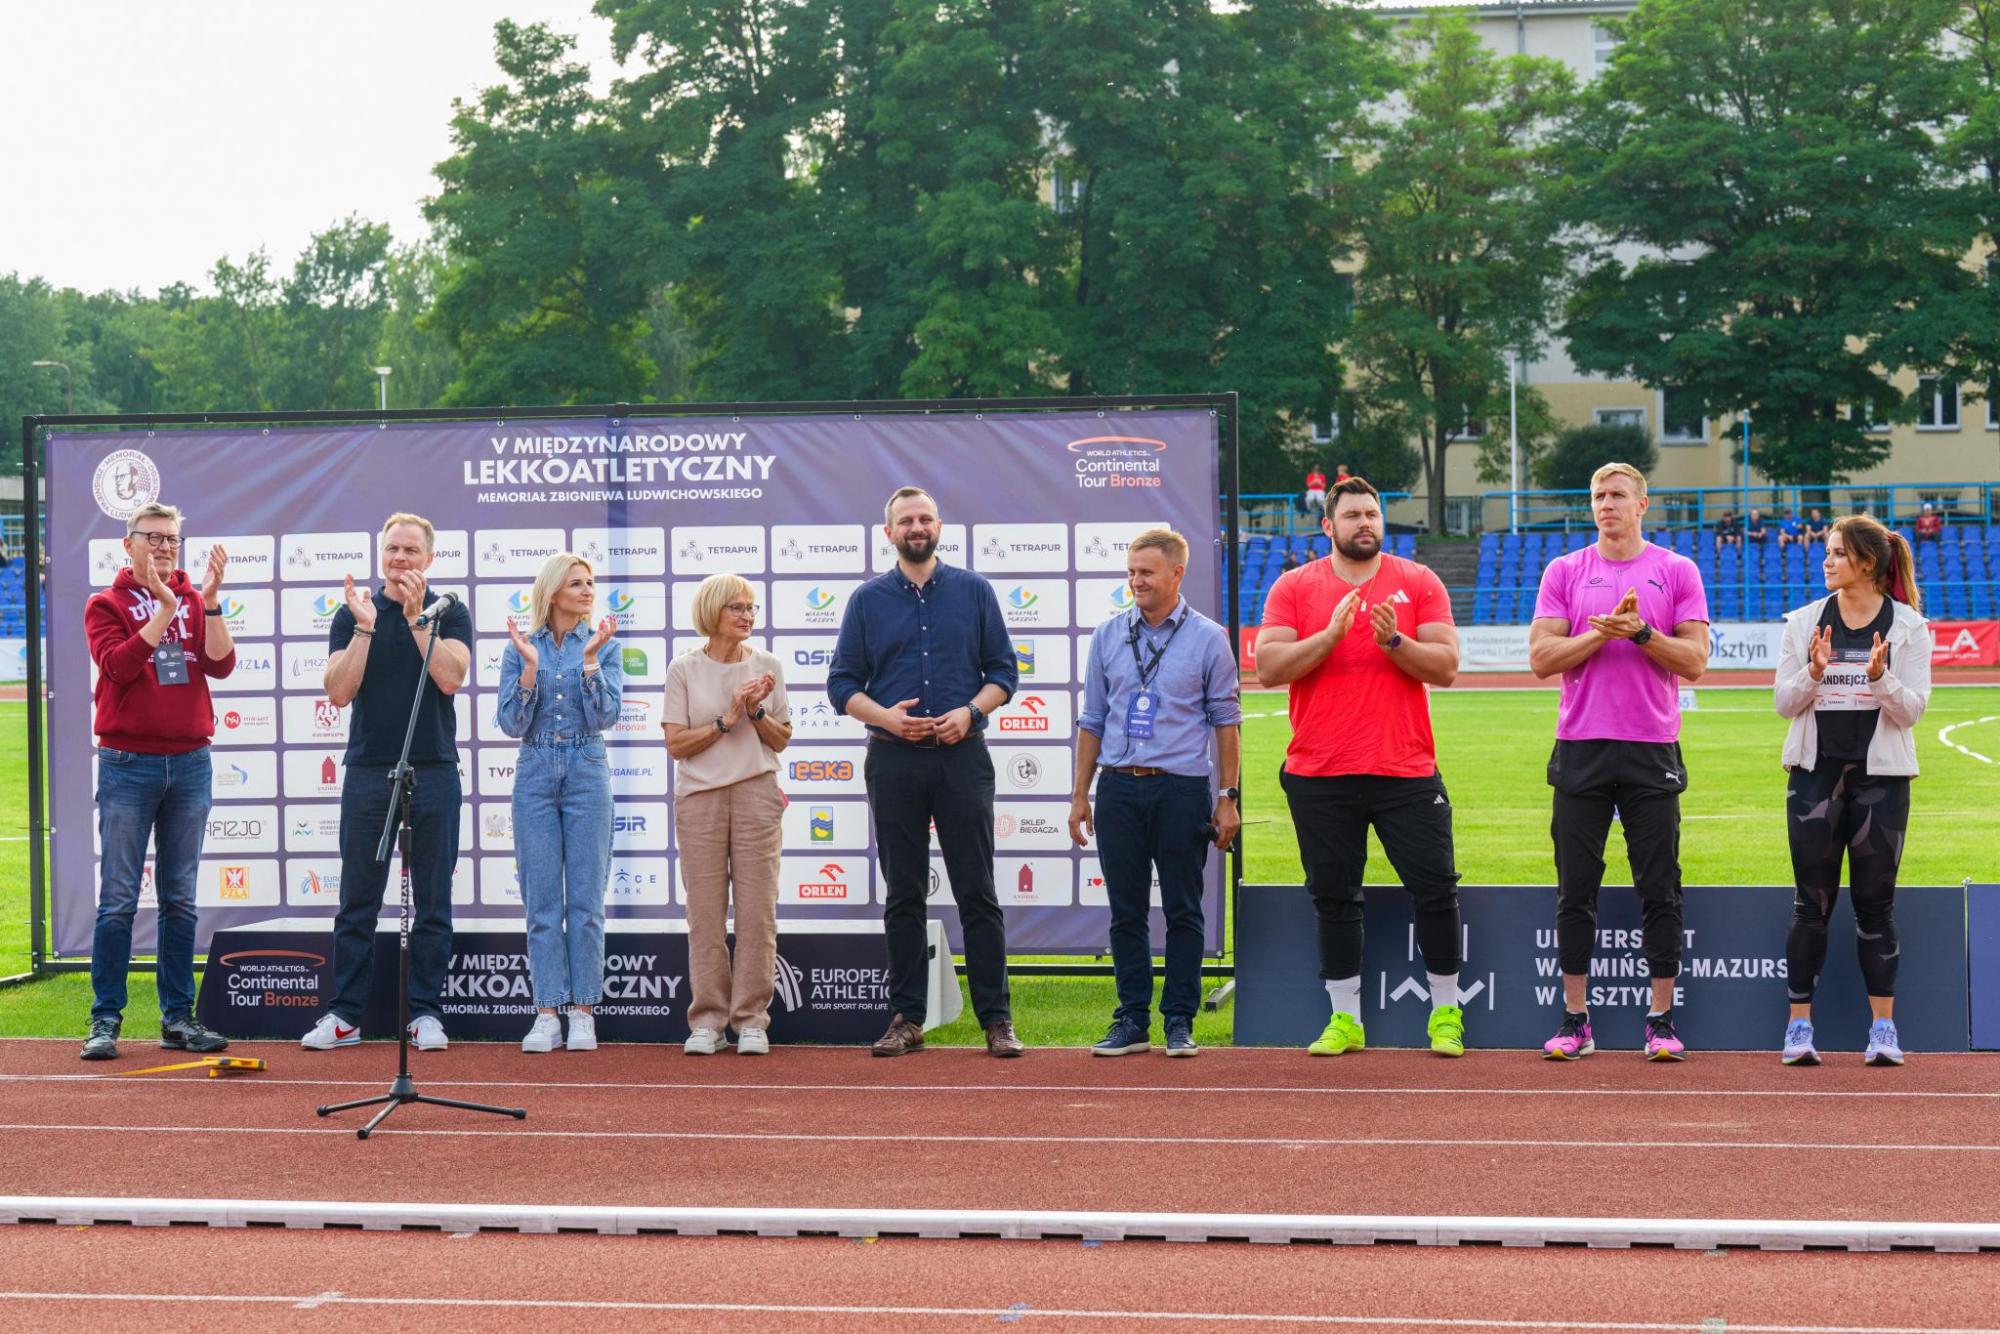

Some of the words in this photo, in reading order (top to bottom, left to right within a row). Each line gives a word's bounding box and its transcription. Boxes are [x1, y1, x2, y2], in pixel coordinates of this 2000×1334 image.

[490, 437, 509, 455] V
[513, 433, 747, 458] MIĘDZYNARODOWY
[1112, 449, 1147, 457] ATHLETICS
[464, 455, 776, 485] LEKKOATLETYCZNY
[1075, 458, 1160, 472] Continental
[1075, 474, 1108, 488] Tour
[1110, 473, 1161, 487] Bronze
[477, 491, 547, 503] MEMORIAŁ
[550, 490, 624, 502] ZBIGNIEWA
[627, 488, 763, 501] LUDWICHOWSKIEGO
[510, 549, 558, 557] TETRAPUR
[608, 548, 657, 556] TETRAPUR
[707, 546, 758, 555] TETRAPUR
[808, 545, 858, 553] TETRAPUR
[1010, 544, 1061, 552] TETRAPUR
[230, 555, 267, 565] TRAPUR
[315, 552, 363, 561] TETRAPUR
[433, 551, 460, 559] APUR
[1931, 628, 1979, 651] LA
[1820, 674, 1868, 687] ANDREJCZ
[616, 713, 647, 722] nental
[1002, 718, 1046, 729] ORLEN
[488, 767, 514, 778] TVP
[609, 768, 653, 777] EGANIE.PL
[614, 816, 646, 831] SiR
[1020, 826, 1059, 834] BIEGACZA
[801, 886, 845, 897] ORLEN
[811, 968, 889, 983] EUROPEA
[228, 974, 318, 989] Continental
[811, 984, 890, 999] ATHLETIC
[1535, 986, 1557, 1006] W
[1563, 986, 1684, 1006] SZTYE
[227, 991, 262, 1006] Tour
[264, 991, 319, 1006] Bronze
[440, 1004, 490, 1015] EMORIAŁ
[492, 1004, 538, 1015] ZBIGNIE
[558, 1005, 670, 1016] LUICHOWSKIEGO
